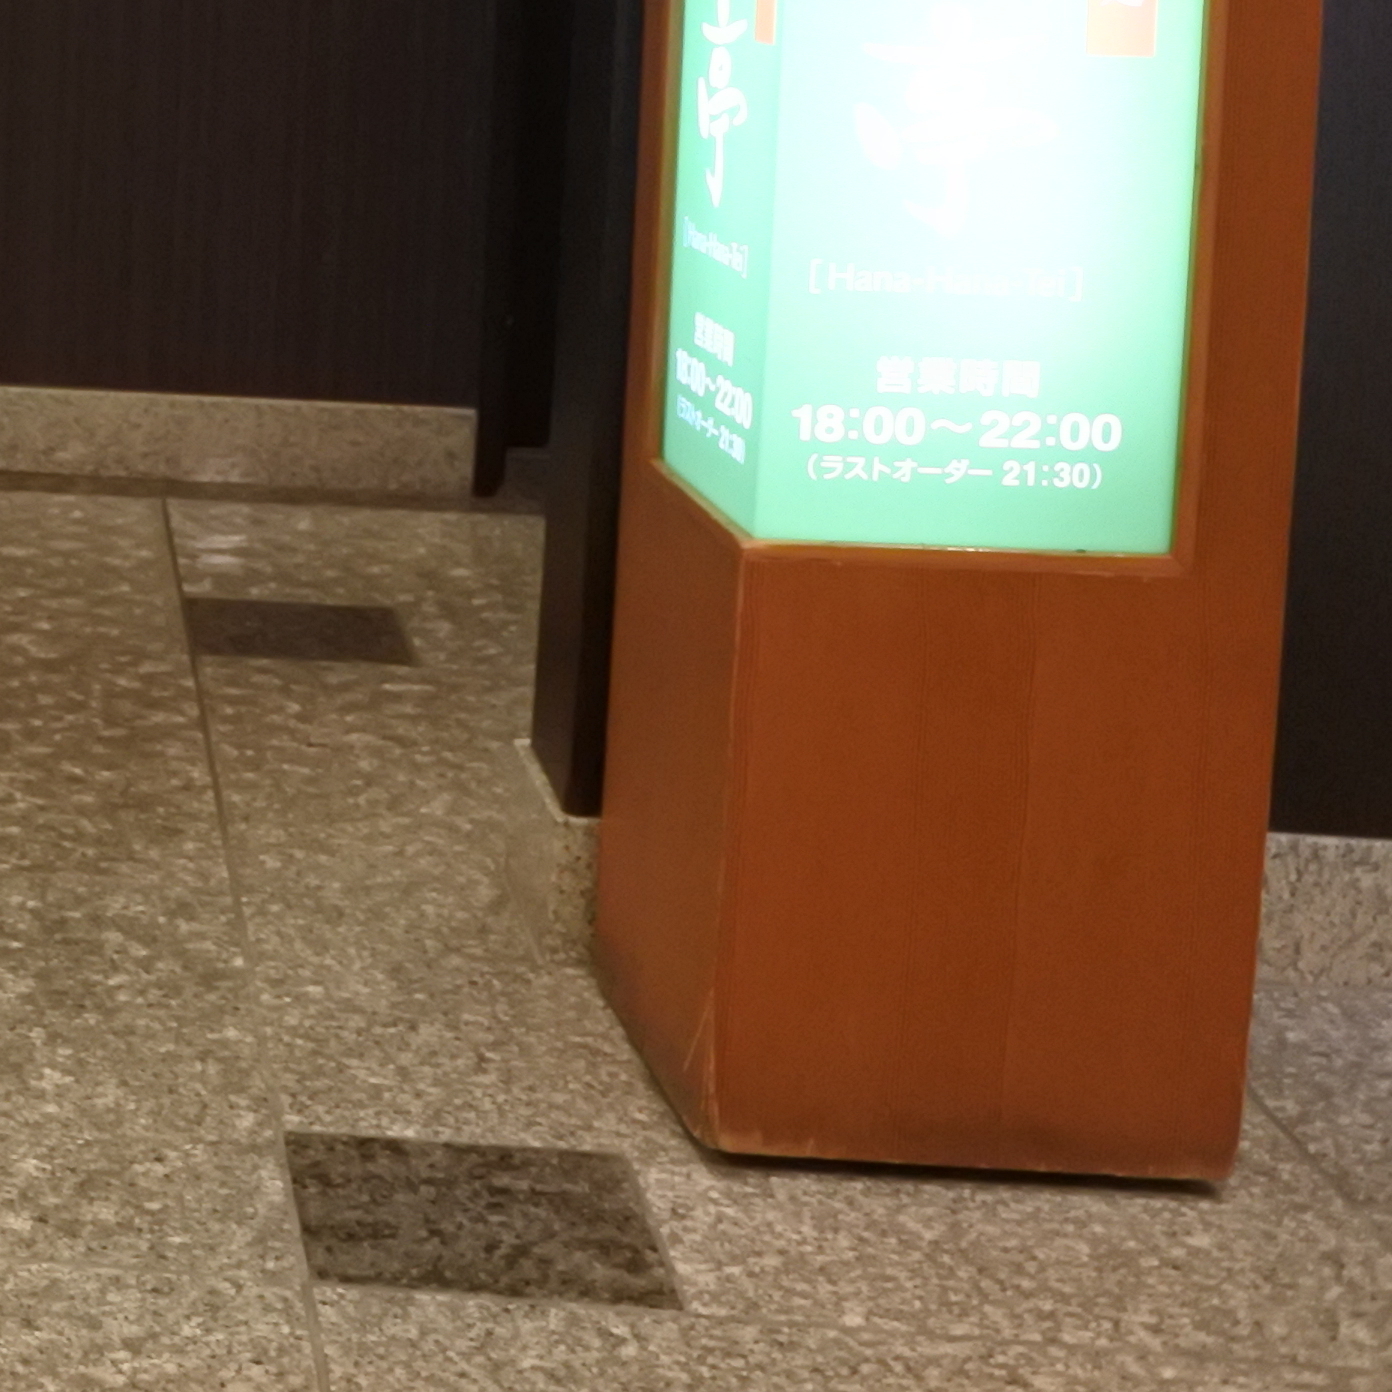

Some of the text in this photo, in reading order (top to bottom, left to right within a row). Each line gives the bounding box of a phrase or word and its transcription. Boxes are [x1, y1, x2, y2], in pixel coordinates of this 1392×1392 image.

[875, 355, 1041, 398] 営業時間
[791, 403, 1123, 452] 18:00～22:00
